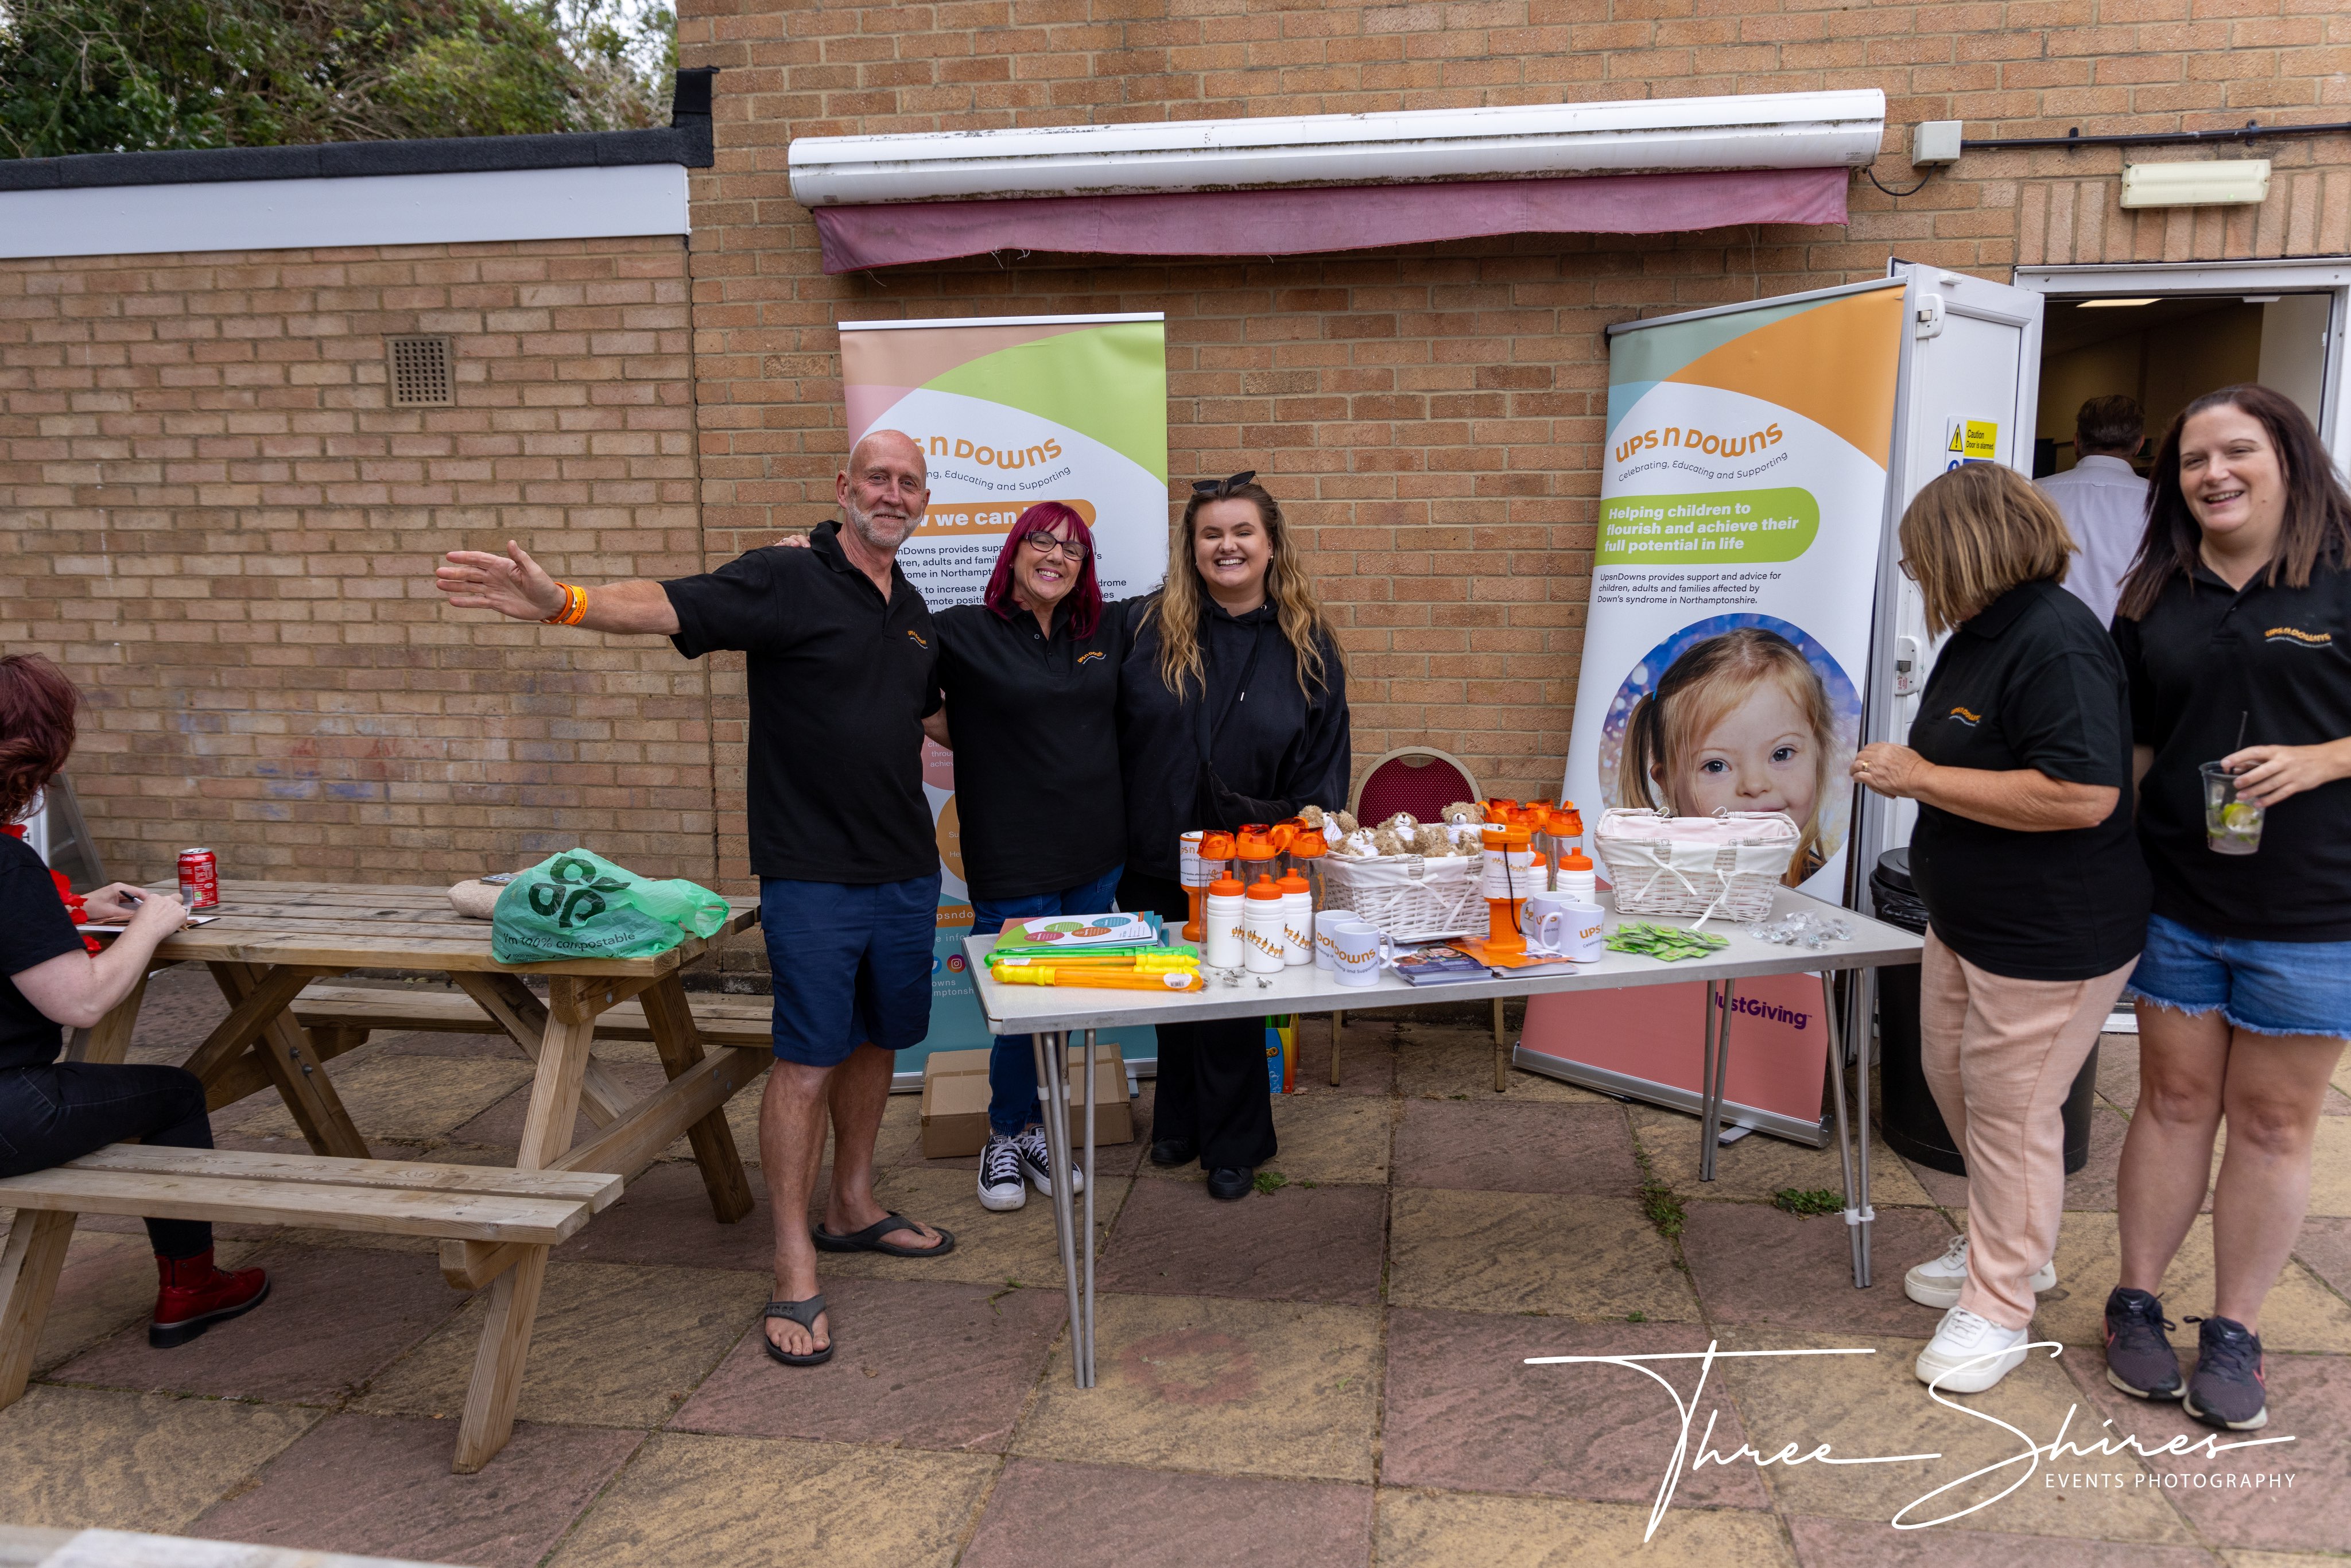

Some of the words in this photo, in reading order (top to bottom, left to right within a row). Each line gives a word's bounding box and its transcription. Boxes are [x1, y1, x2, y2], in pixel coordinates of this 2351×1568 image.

[1968, 429, 1984, 439] Caution
[1966, 440, 1976, 448] Door
[1619, 461, 1669, 482] Celebrating,
[1673, 460, 1714, 479] Educating
[1717, 471, 1734, 479] and
[1737, 452, 1788, 479] Supporting
[945, 470, 994, 490] Educating
[996, 483, 1015, 491] and
[1019, 466, 1071, 491] Supporting
[1608, 506, 1664, 521] Helping
[1667, 504, 1731, 518] children
[1735, 503, 1751, 514] to
[934, 513, 969, 527] we
[974, 510, 1017, 526] can
[1607, 522, 1661, 535] flourish
[1665, 522, 1694, 534] and
[1697, 519, 1758, 534] achieve
[1762, 517, 1799, 531] their
[896, 546, 936, 555] nDowns
[939, 545, 979, 556] provides
[982, 545, 1005, 554] supp
[1604, 540, 1625, 552] full
[1628, 538, 1698, 554] potential
[1701, 538, 1716, 550] in
[1719, 537, 1744, 550] life
[922, 557, 952, 566] adults
[955, 557, 972, 565] and
[975, 555, 999, 564] famili
[941, 568, 994, 579] Northampto
[1600, 573, 1646, 582] UpsnDowns
[1648, 573, 1685, 582] provides
[1687, 573, 1719, 582] support
[1721, 572, 1737, 580] and
[1740, 572, 1767, 580] advice
[1770, 571, 1781, 580] for
[937, 585, 977, 593] increase
[1599, 584, 1630, 592] children,
[1679, 584, 1710, 592] families
[1713, 584, 1747, 592] affected
[1749, 584, 1760, 593] by
[926, 597, 953, 606] omote
[957, 596, 986, 605] positiv
[1625, 596, 1667, 605] syndrome
[1679, 596, 1758, 606] Northamptonshire.
[503, 933, 517, 945] I'm
[556, 933, 635, 952] compostable
